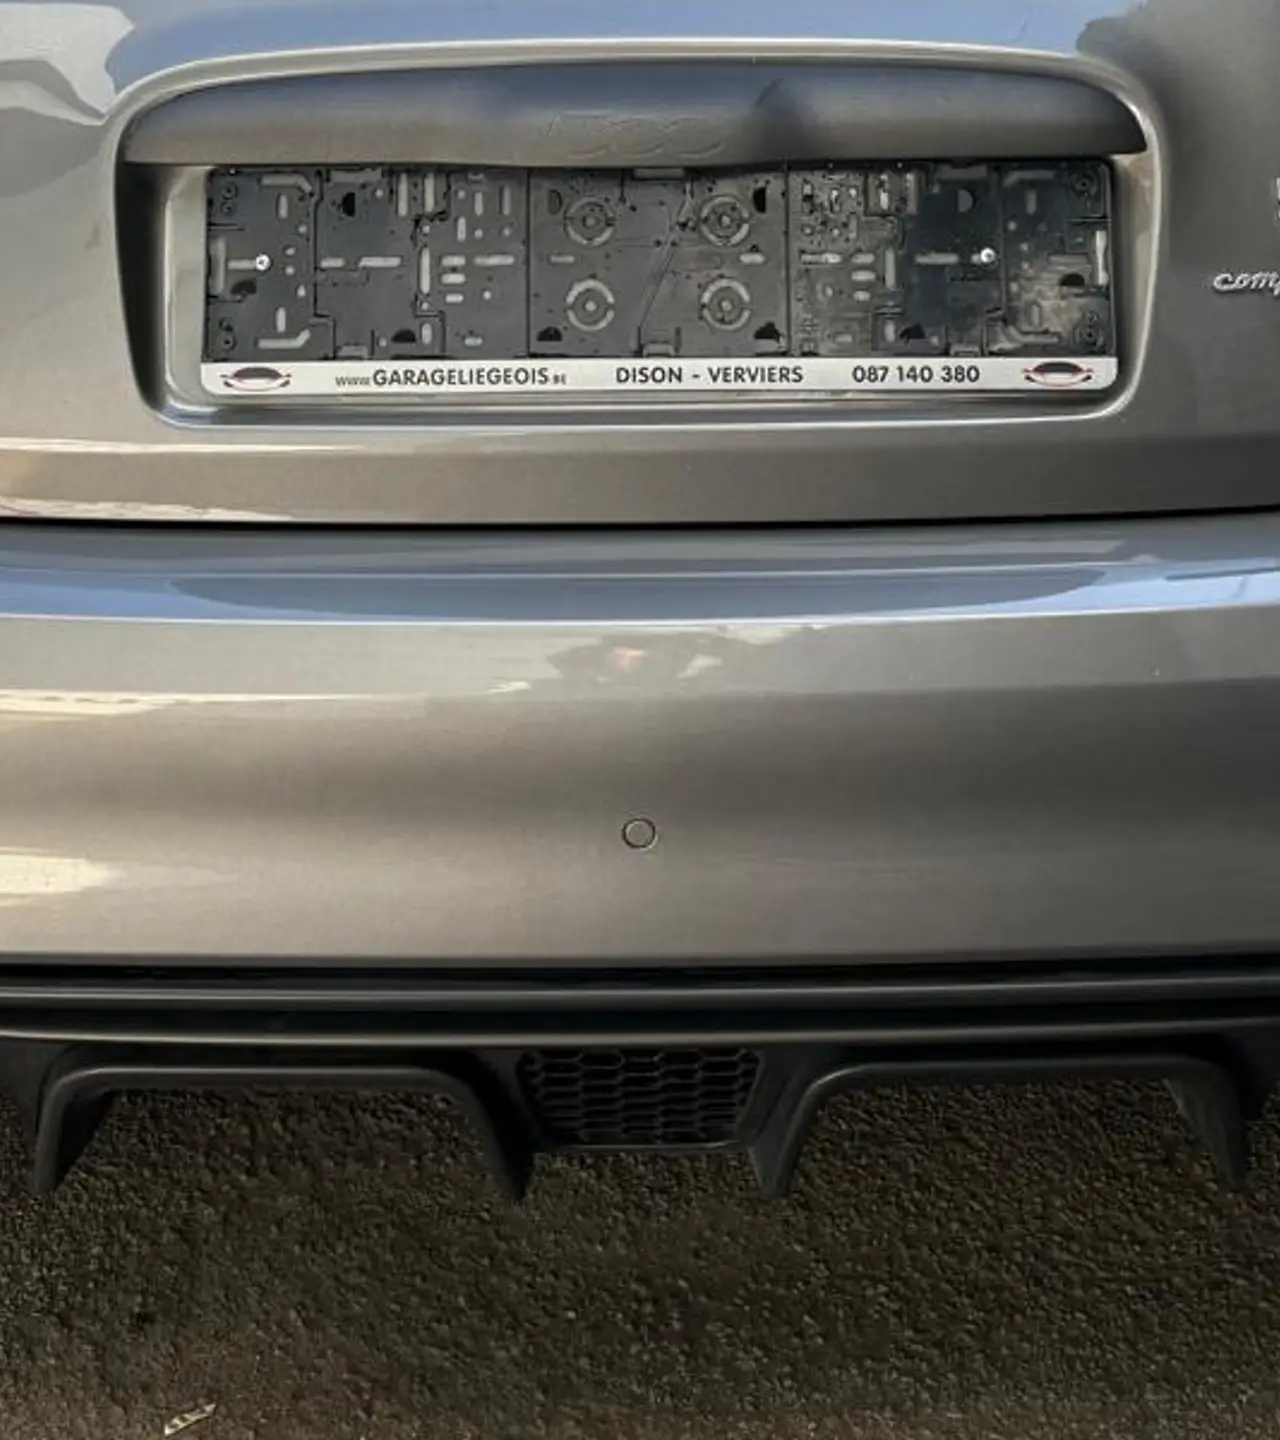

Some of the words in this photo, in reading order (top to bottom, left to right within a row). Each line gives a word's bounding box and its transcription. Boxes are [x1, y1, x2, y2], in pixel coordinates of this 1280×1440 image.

[616, 366, 683, 384] DISON
[707, 365, 804, 384] VERVIERS
[852, 364, 889, 383] 087
[898, 364, 933, 383] 140
[940, 364, 980, 383] 380
